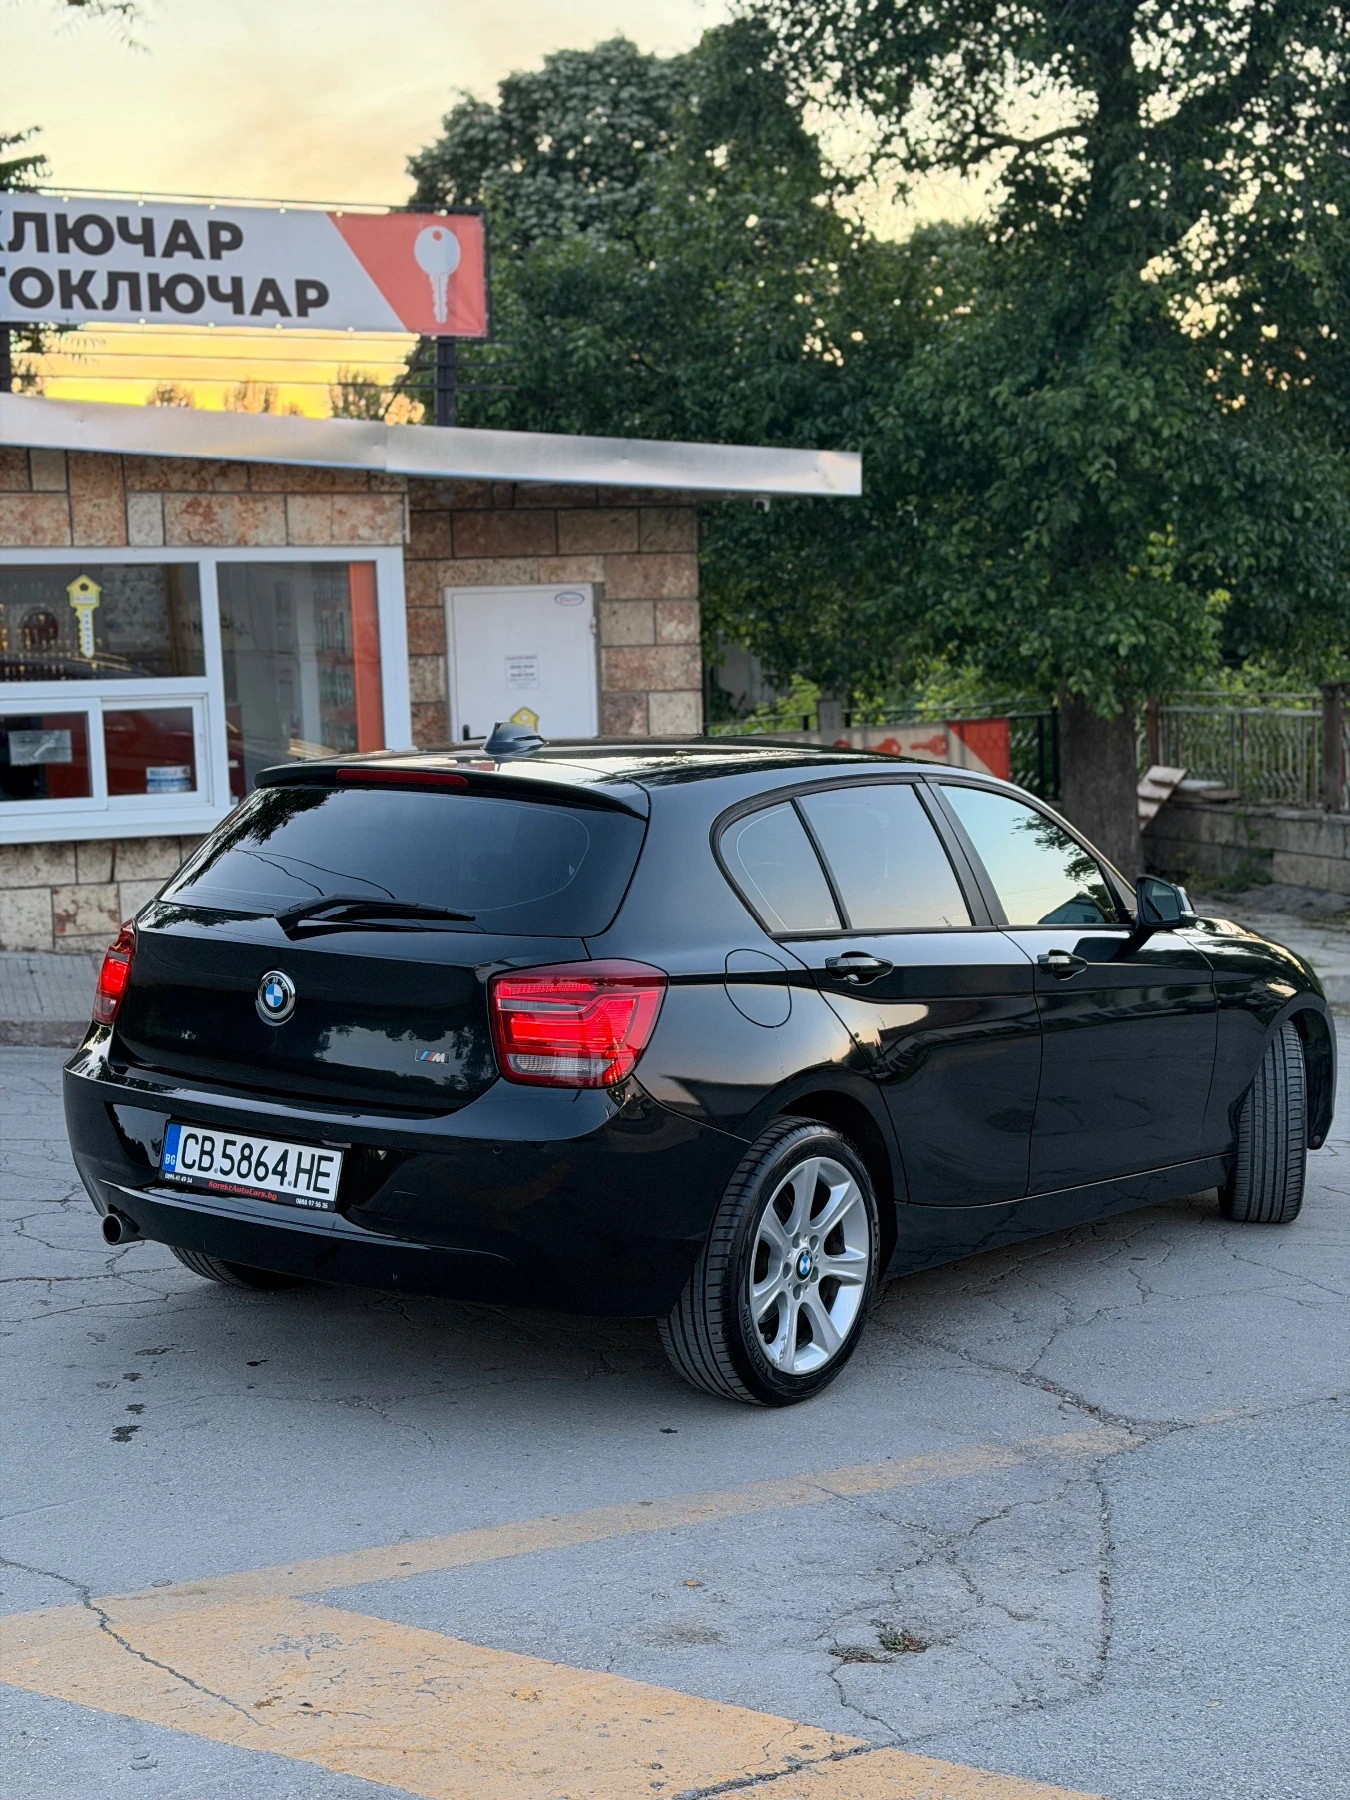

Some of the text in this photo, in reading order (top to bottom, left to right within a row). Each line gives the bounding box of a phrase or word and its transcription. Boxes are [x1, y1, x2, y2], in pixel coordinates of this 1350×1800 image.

[0, 266, 330, 318] ОКЛЮЧАР
[165, 1153, 176, 1166] BG
[208, 1180, 278, 1202] KorektAutoCars.bg
